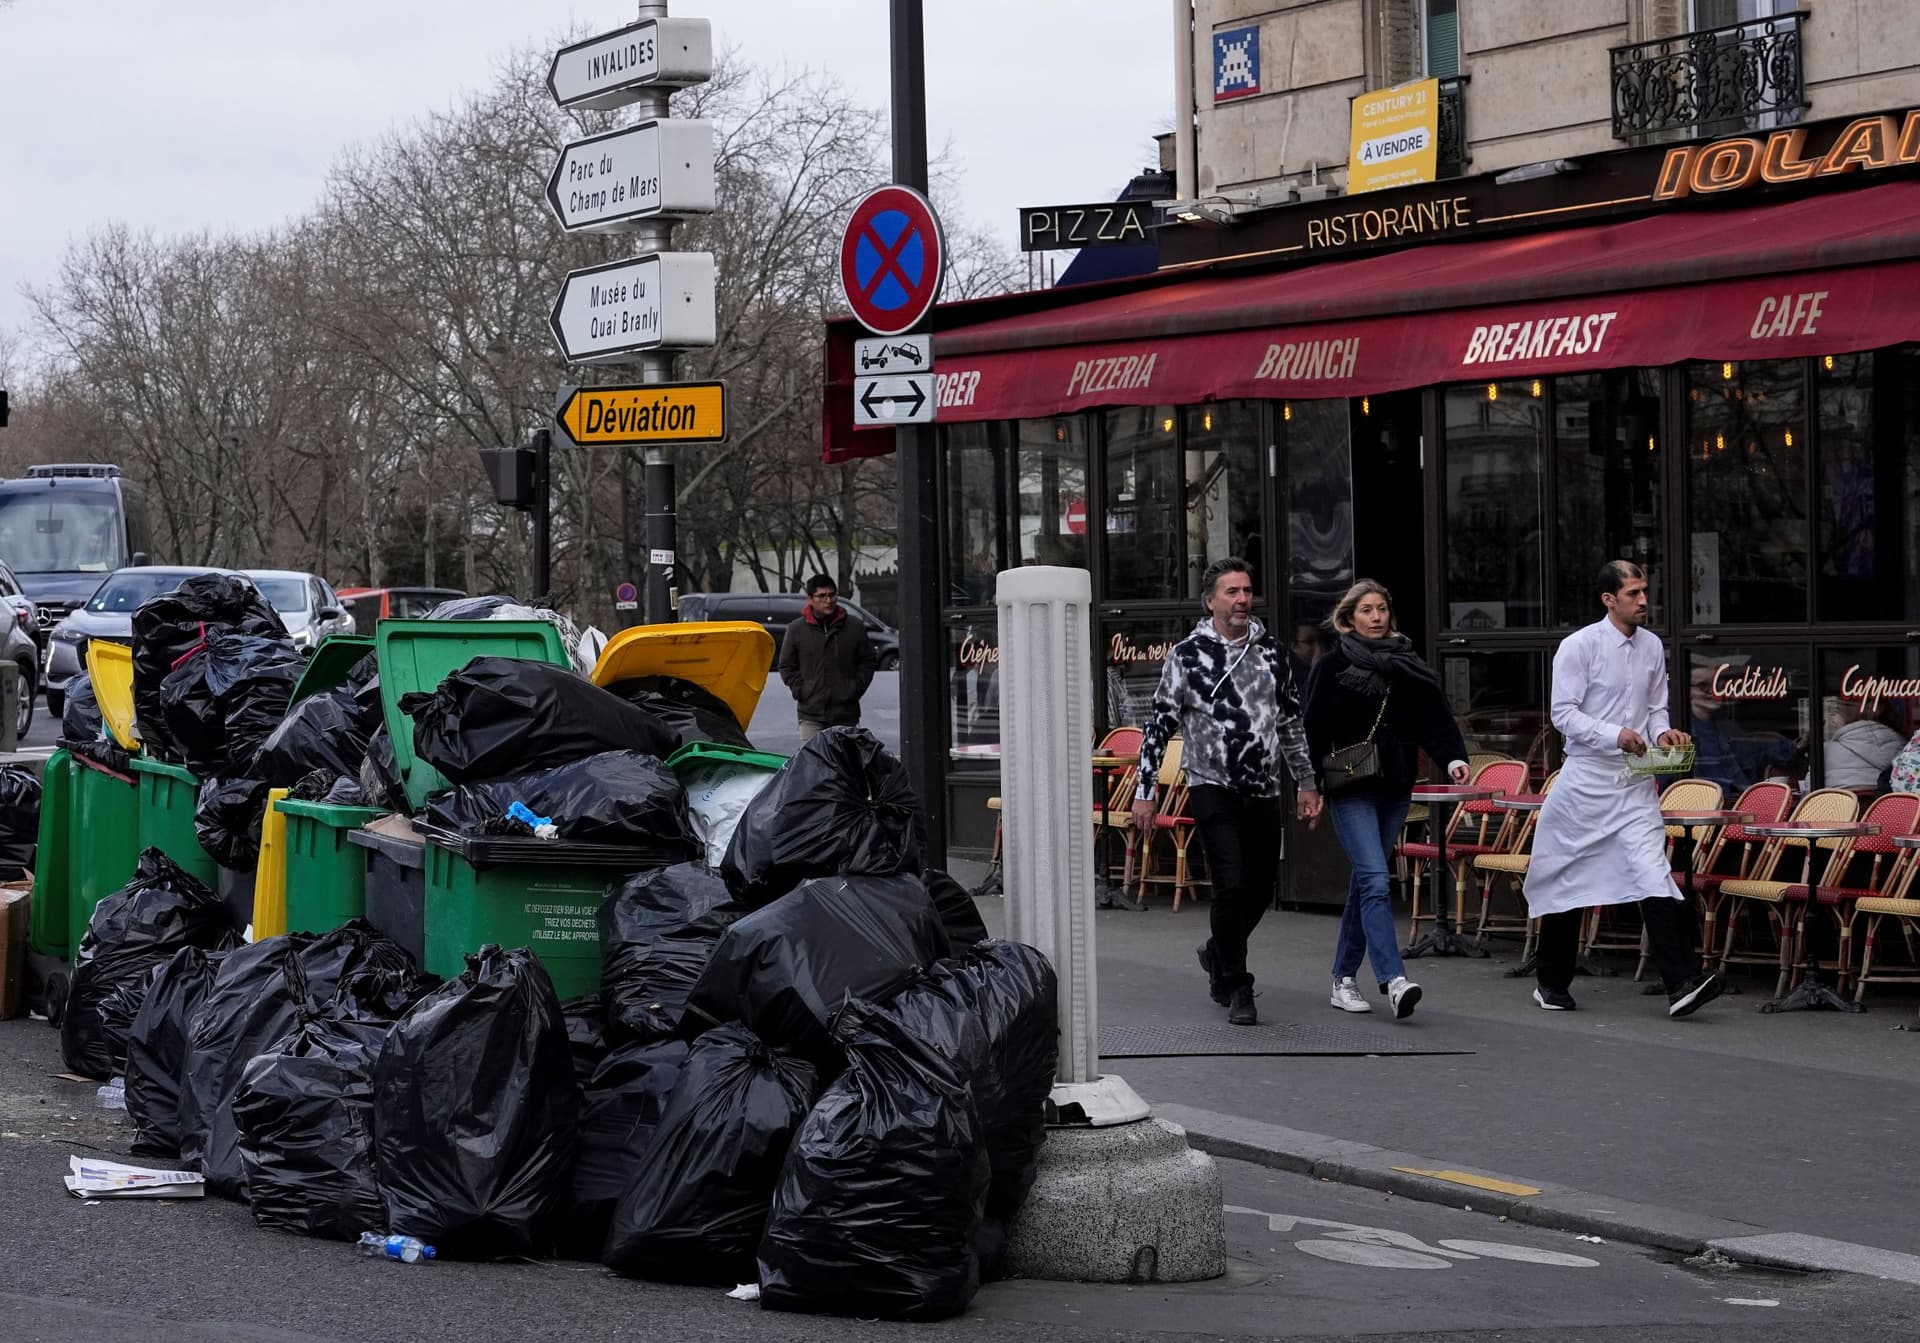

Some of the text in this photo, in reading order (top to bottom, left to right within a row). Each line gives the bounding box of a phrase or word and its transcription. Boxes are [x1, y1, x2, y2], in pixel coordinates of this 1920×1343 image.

[588, 39, 655, 81] INVALIDES
[1362, 90, 1426, 117] CENTURY 21
[1364, 134, 1423, 161] À VENDRE
[569, 153, 613, 183] Parc du
[569, 174, 658, 214] Champ de Mars
[1028, 207, 1146, 244] PIZZA
[1308, 196, 1472, 249] RISTORANTE
[590, 278, 646, 309] Musée du
[590, 309, 659, 340] Quai Branly
[1750, 291, 1829, 340] CAFE
[1462, 311, 1618, 366] BREAKFAST
[1066, 353, 1158, 397] PIZZERIA
[1254, 337, 1360, 380] BRUNCH
[935, 370, 981, 408] RGER
[585, 395, 696, 435] Déviation
[960, 633, 999, 675] Crêpe
[1111, 632, 1137, 661] Vin
[1712, 663, 1788, 698] Cocktails
[544, 917, 559, 927] TRIEZ
[560, 918, 571, 928] VOS
